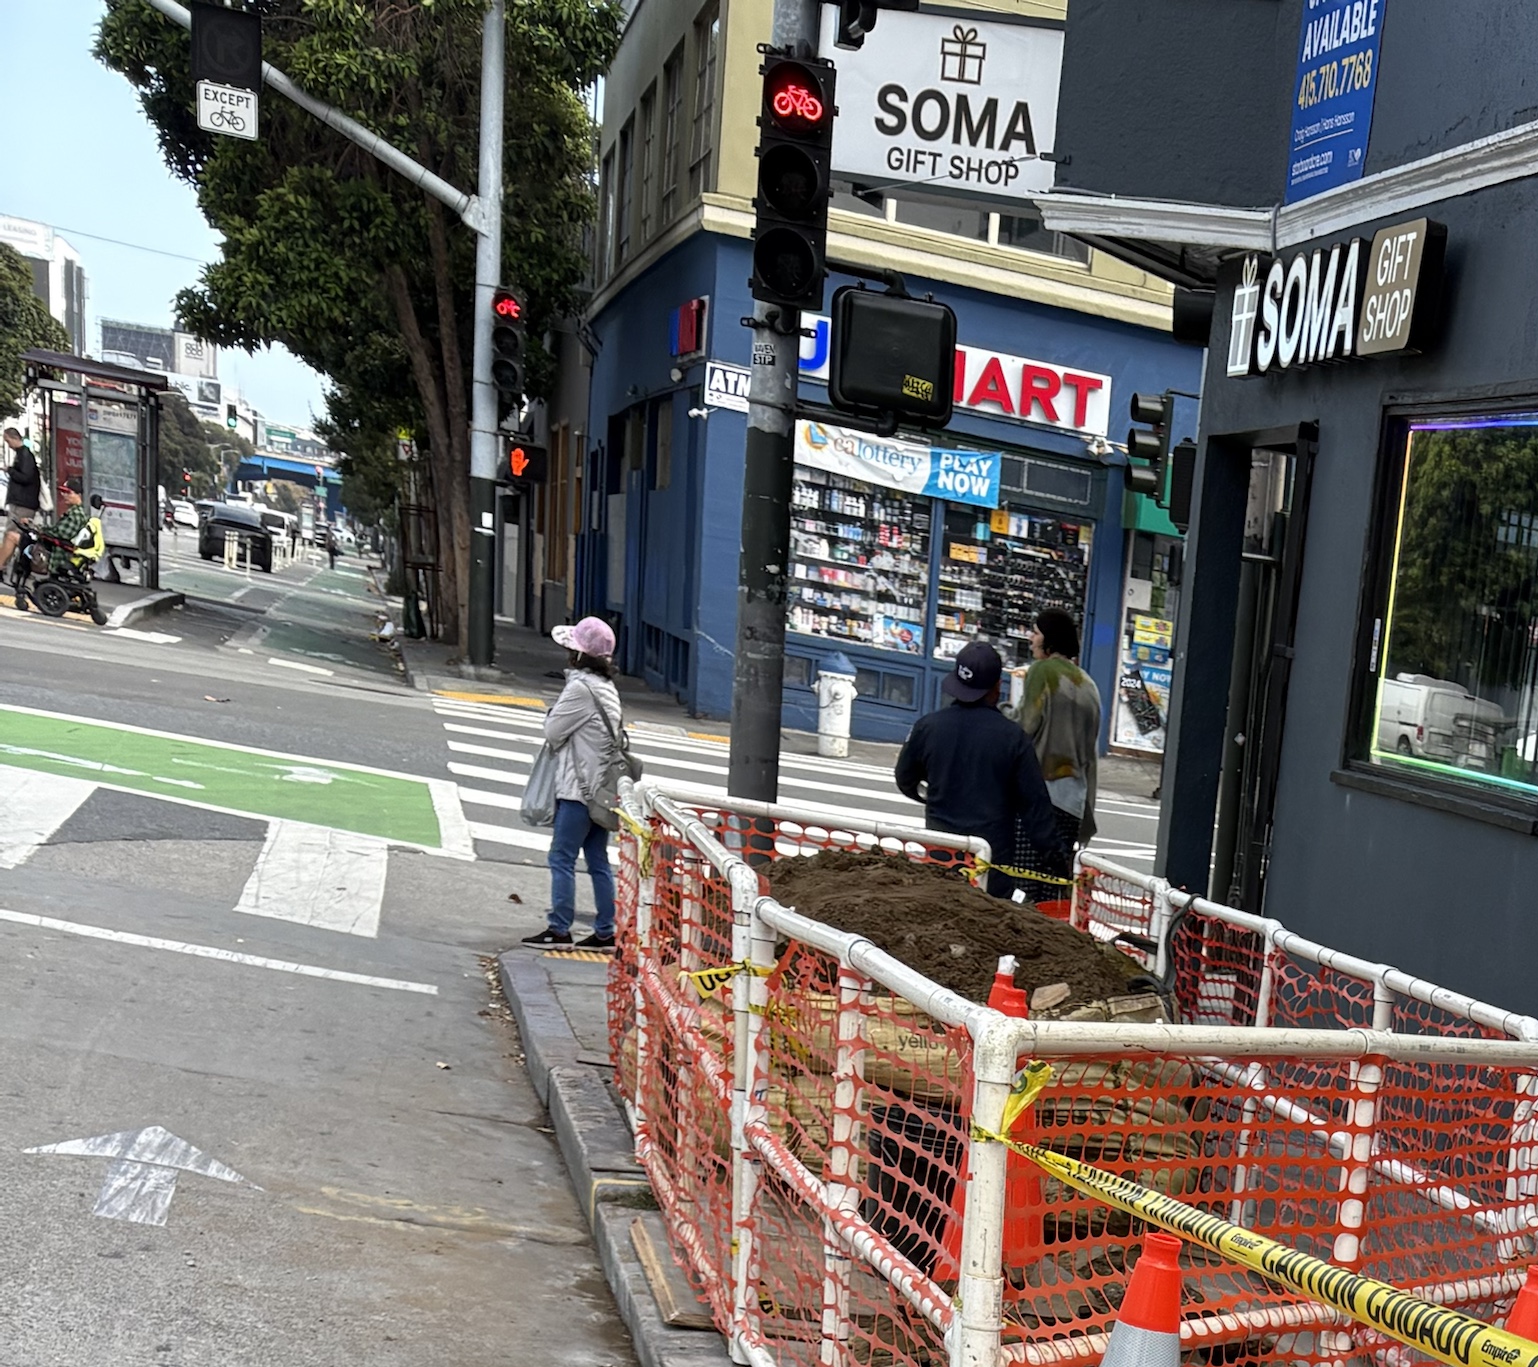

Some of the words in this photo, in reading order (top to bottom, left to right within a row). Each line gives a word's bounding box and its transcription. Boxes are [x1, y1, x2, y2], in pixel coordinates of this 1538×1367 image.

[1302, 0, 1378, 63] AVAILABLE
[204, 88, 251, 109] EXCEPT
[1298, 49, 1373, 110] 415.710.7768
[874, 83, 1037, 155] SOMA
[887, 146, 943, 176] GIFT
[949, 155, 1019, 187] SHOP
[1376, 231, 1418, 287] GIFT
[1257, 238, 1361, 373] SOMA
[1363, 288, 1412, 342] SHOP
[953, 349, 1103, 429] ART
[937, 471, 991, 498] NOW
[939, 452, 993, 478] PLAY
[1121, 677, 1142, 690] 2024
[1261, 1243, 1369, 1313] CAUTION
[1366, 1287, 1488, 1365] CUIDADO
[1481, 1339, 1518, 1366] Empire
